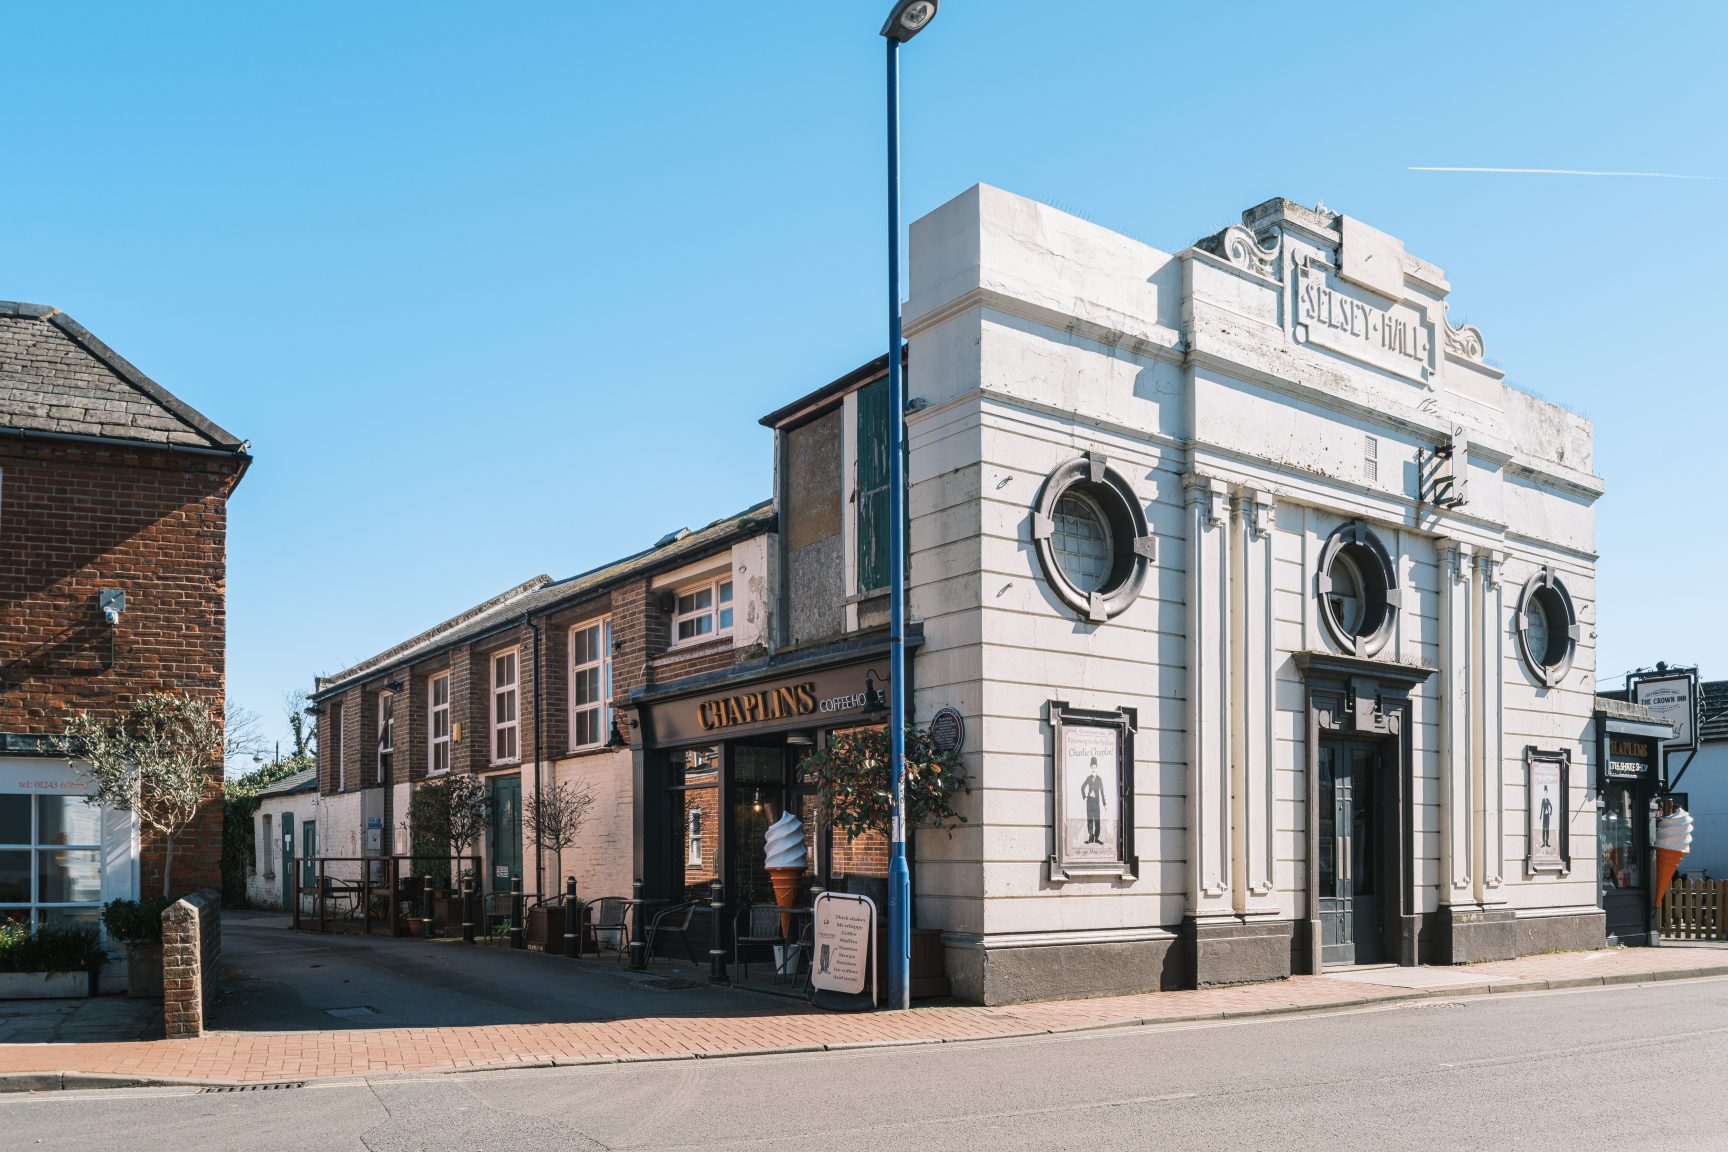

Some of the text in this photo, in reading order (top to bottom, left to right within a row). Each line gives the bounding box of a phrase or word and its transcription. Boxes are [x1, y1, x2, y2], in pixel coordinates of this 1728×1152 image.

[1305, 283, 1424, 362] SELSEY HALL
[697, 682, 816, 731] CHAPLINS
[1653, 697, 1675, 705] CROWN
[1611, 740, 1648, 757] HAPLINS
